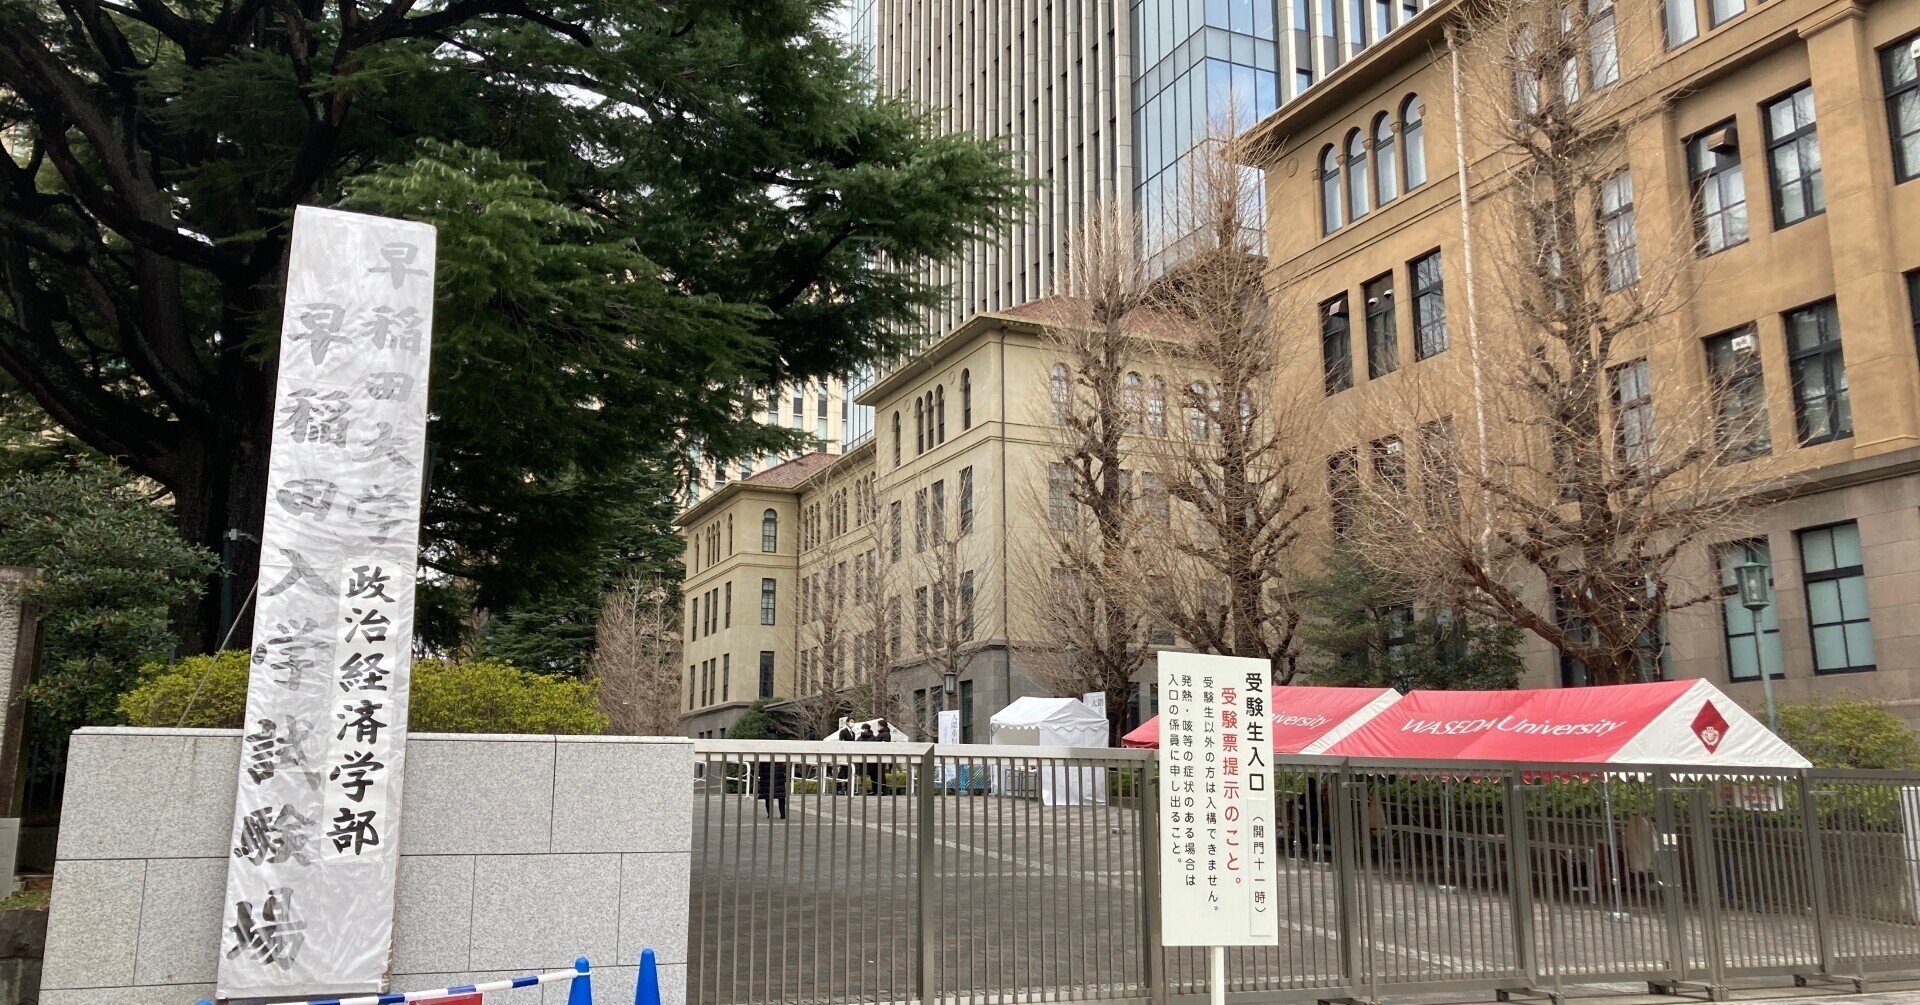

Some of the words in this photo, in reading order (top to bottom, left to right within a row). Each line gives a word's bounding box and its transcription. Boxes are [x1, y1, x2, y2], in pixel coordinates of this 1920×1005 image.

[326, 564, 395, 855] 政治経済学部
[1168, 673, 1182, 863] 入口の係員に申し出ること。
[1181, 674, 1196, 886] 発熱・咳等の症状のある場合は
[1203, 676, 1219, 911] 受験生以外の方は入構できません。
[1221, 687, 1241, 883] 受験票提示のこと。
[1245, 672, 1265, 792] 受験生入口
[1401, 718, 1498, 735] WASEDA
[1496, 715, 1627, 737] University
